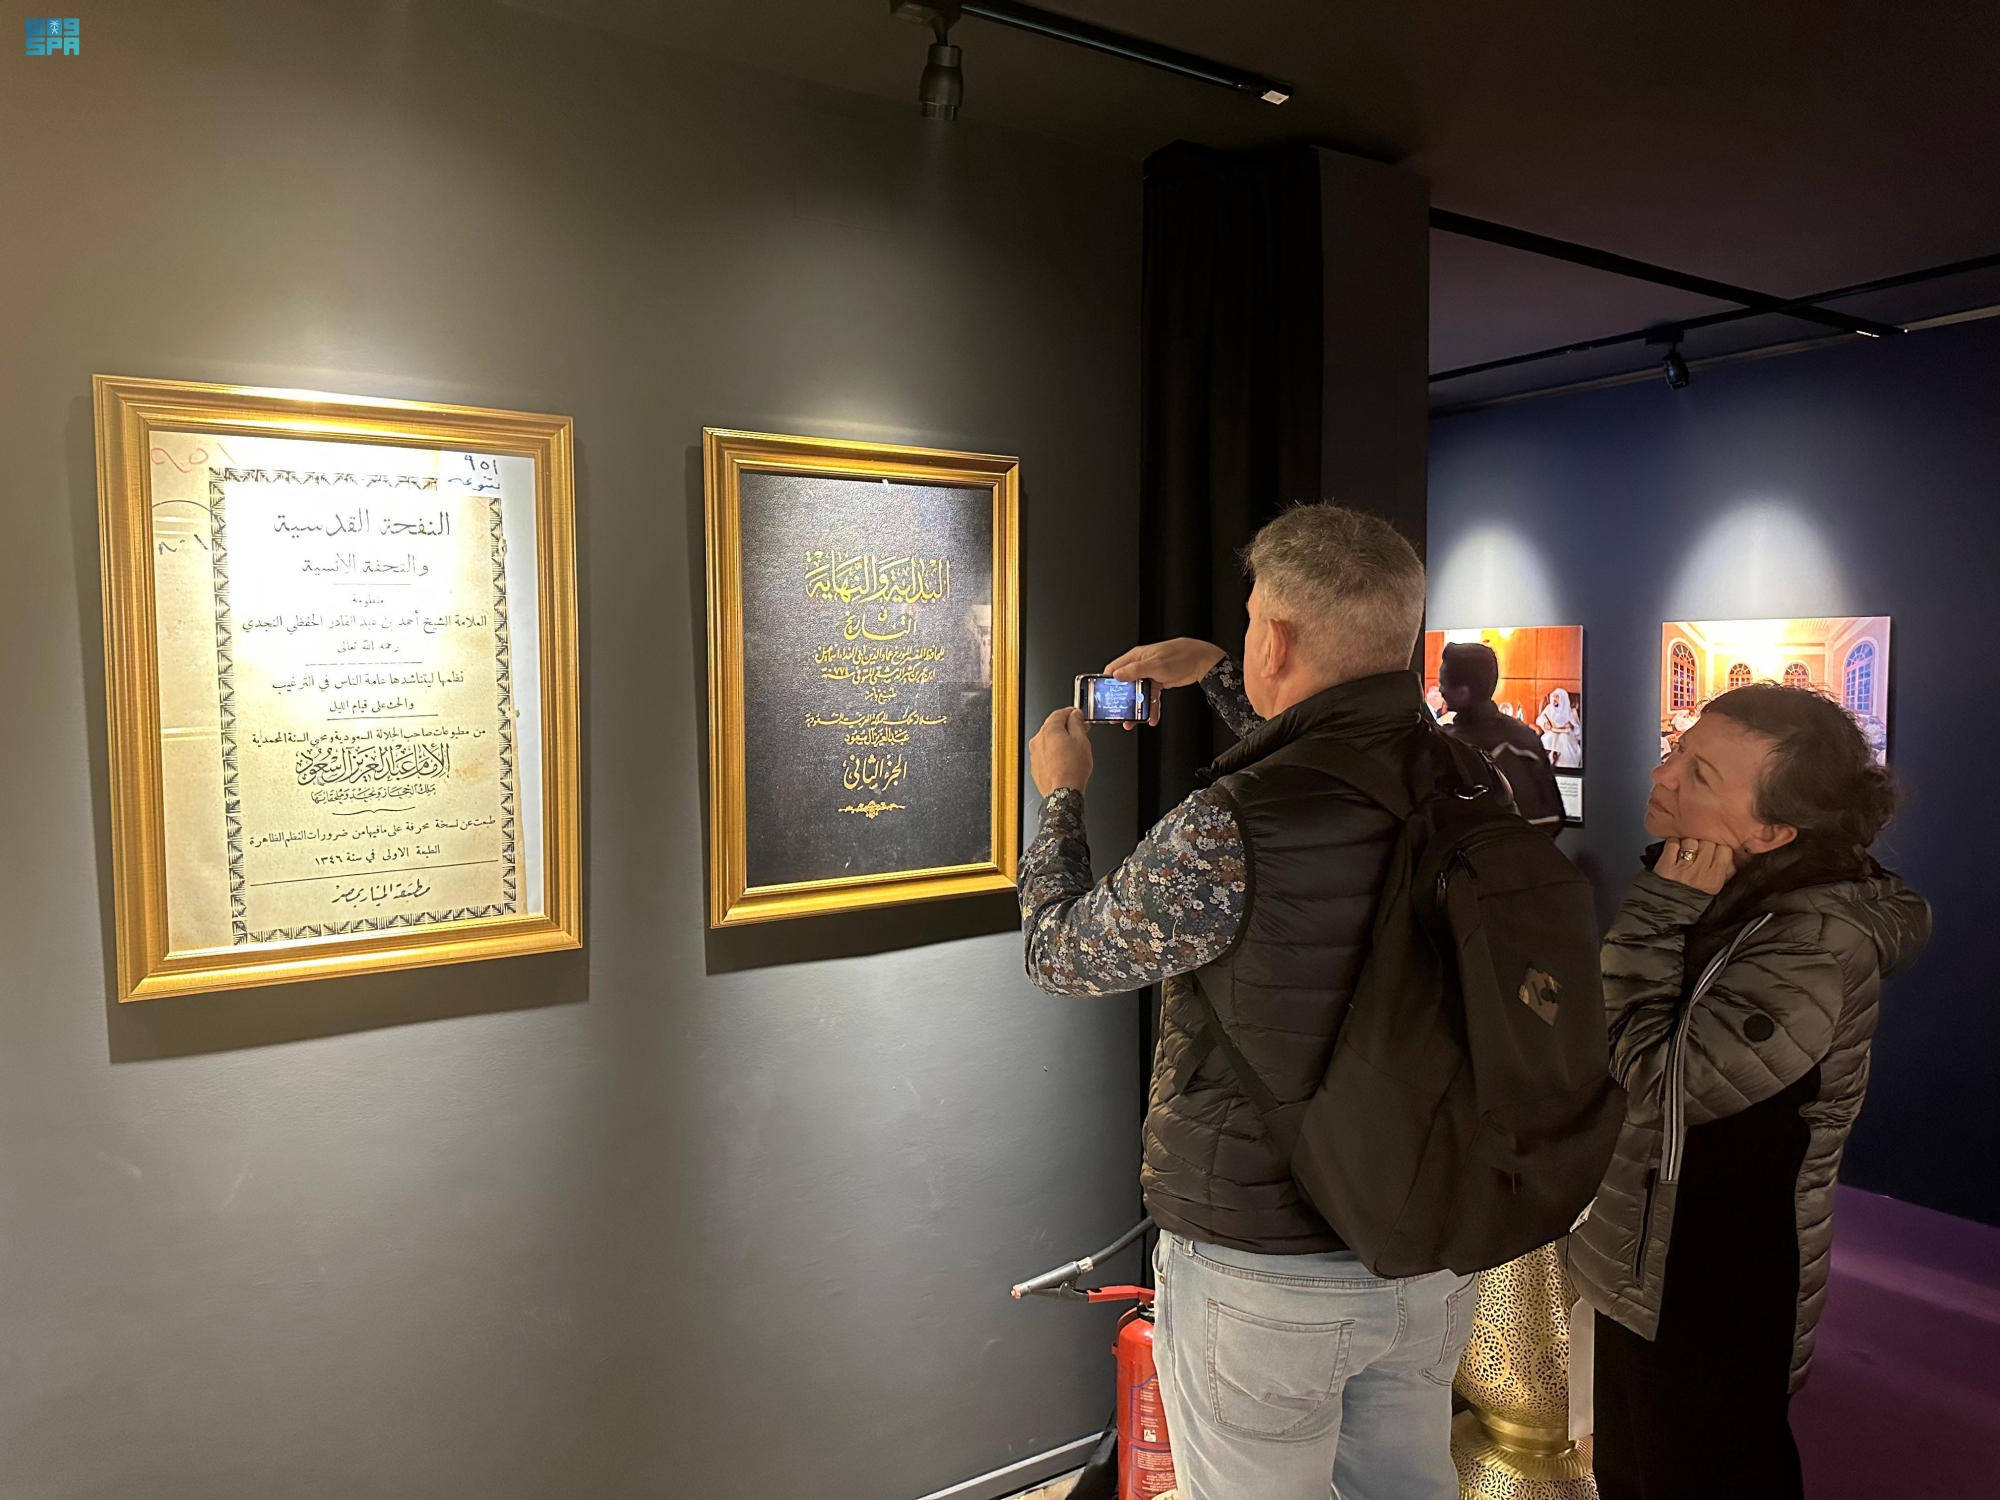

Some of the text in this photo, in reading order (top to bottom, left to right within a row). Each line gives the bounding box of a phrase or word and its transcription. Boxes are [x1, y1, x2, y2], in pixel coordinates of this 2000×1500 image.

[273, 507, 450, 539] النفحة القدسية
[362, 553, 429, 577] والتحفة
[805, 550, 951, 604] البداية والنهاية
[352, 593, 384, 608] منظومة
[242, 609, 487, 635] العلامة الشيخ أحمد بن عبد القادر الحفظي النجدي
[843, 611, 918, 641] التاريخ
[337, 639, 399, 654] رحمه الله تعالى
[861, 646, 883, 666] الدين
[272, 675, 315, 695] الترغيب
[318, 674, 330, 693] في
[334, 674, 362, 690] الناس
[364, 672, 386, 685] عامة
[437, 670, 464, 688] نظمها
[329, 696, 414, 715] والحث على قيام الليل
[804, 711, 844, 728] السعودية
[252, 730, 287, 748] المحمدية
[288, 732, 309, 743] السنة
[334, 729, 373, 744] السعودية
[376, 726, 403, 741] الجلالة
[403, 726, 433, 742] صاحب
[433, 726, 470, 740] مطبوعات
[473, 728, 486, 738] من
[844, 729, 867, 745] سعود
[870, 727, 892, 748] العزيز
[891, 728, 910, 746] عبد
[882, 754, 907, 791] الجزء
[417, 783, 436, 797] ملك
[435, 818, 459, 830] نسخة
[459, 820, 475, 831] عن
[473, 815, 496, 829] طبعت
[284, 829, 307, 848] النظم
[306, 828, 348, 842] ضرورات
[352, 829, 365, 839] من
[387, 824, 402, 837] على
[249, 831, 285, 848] الظاهرة
[346, 852, 362, 862] سنة
[365, 848, 376, 863] في
[416, 843, 440, 858] الطبعة
[315, 854, 343, 866] ١٣٤٦
[331, 884, 364, 908] بمصر
[392, 878, 431, 903] مطبعة
